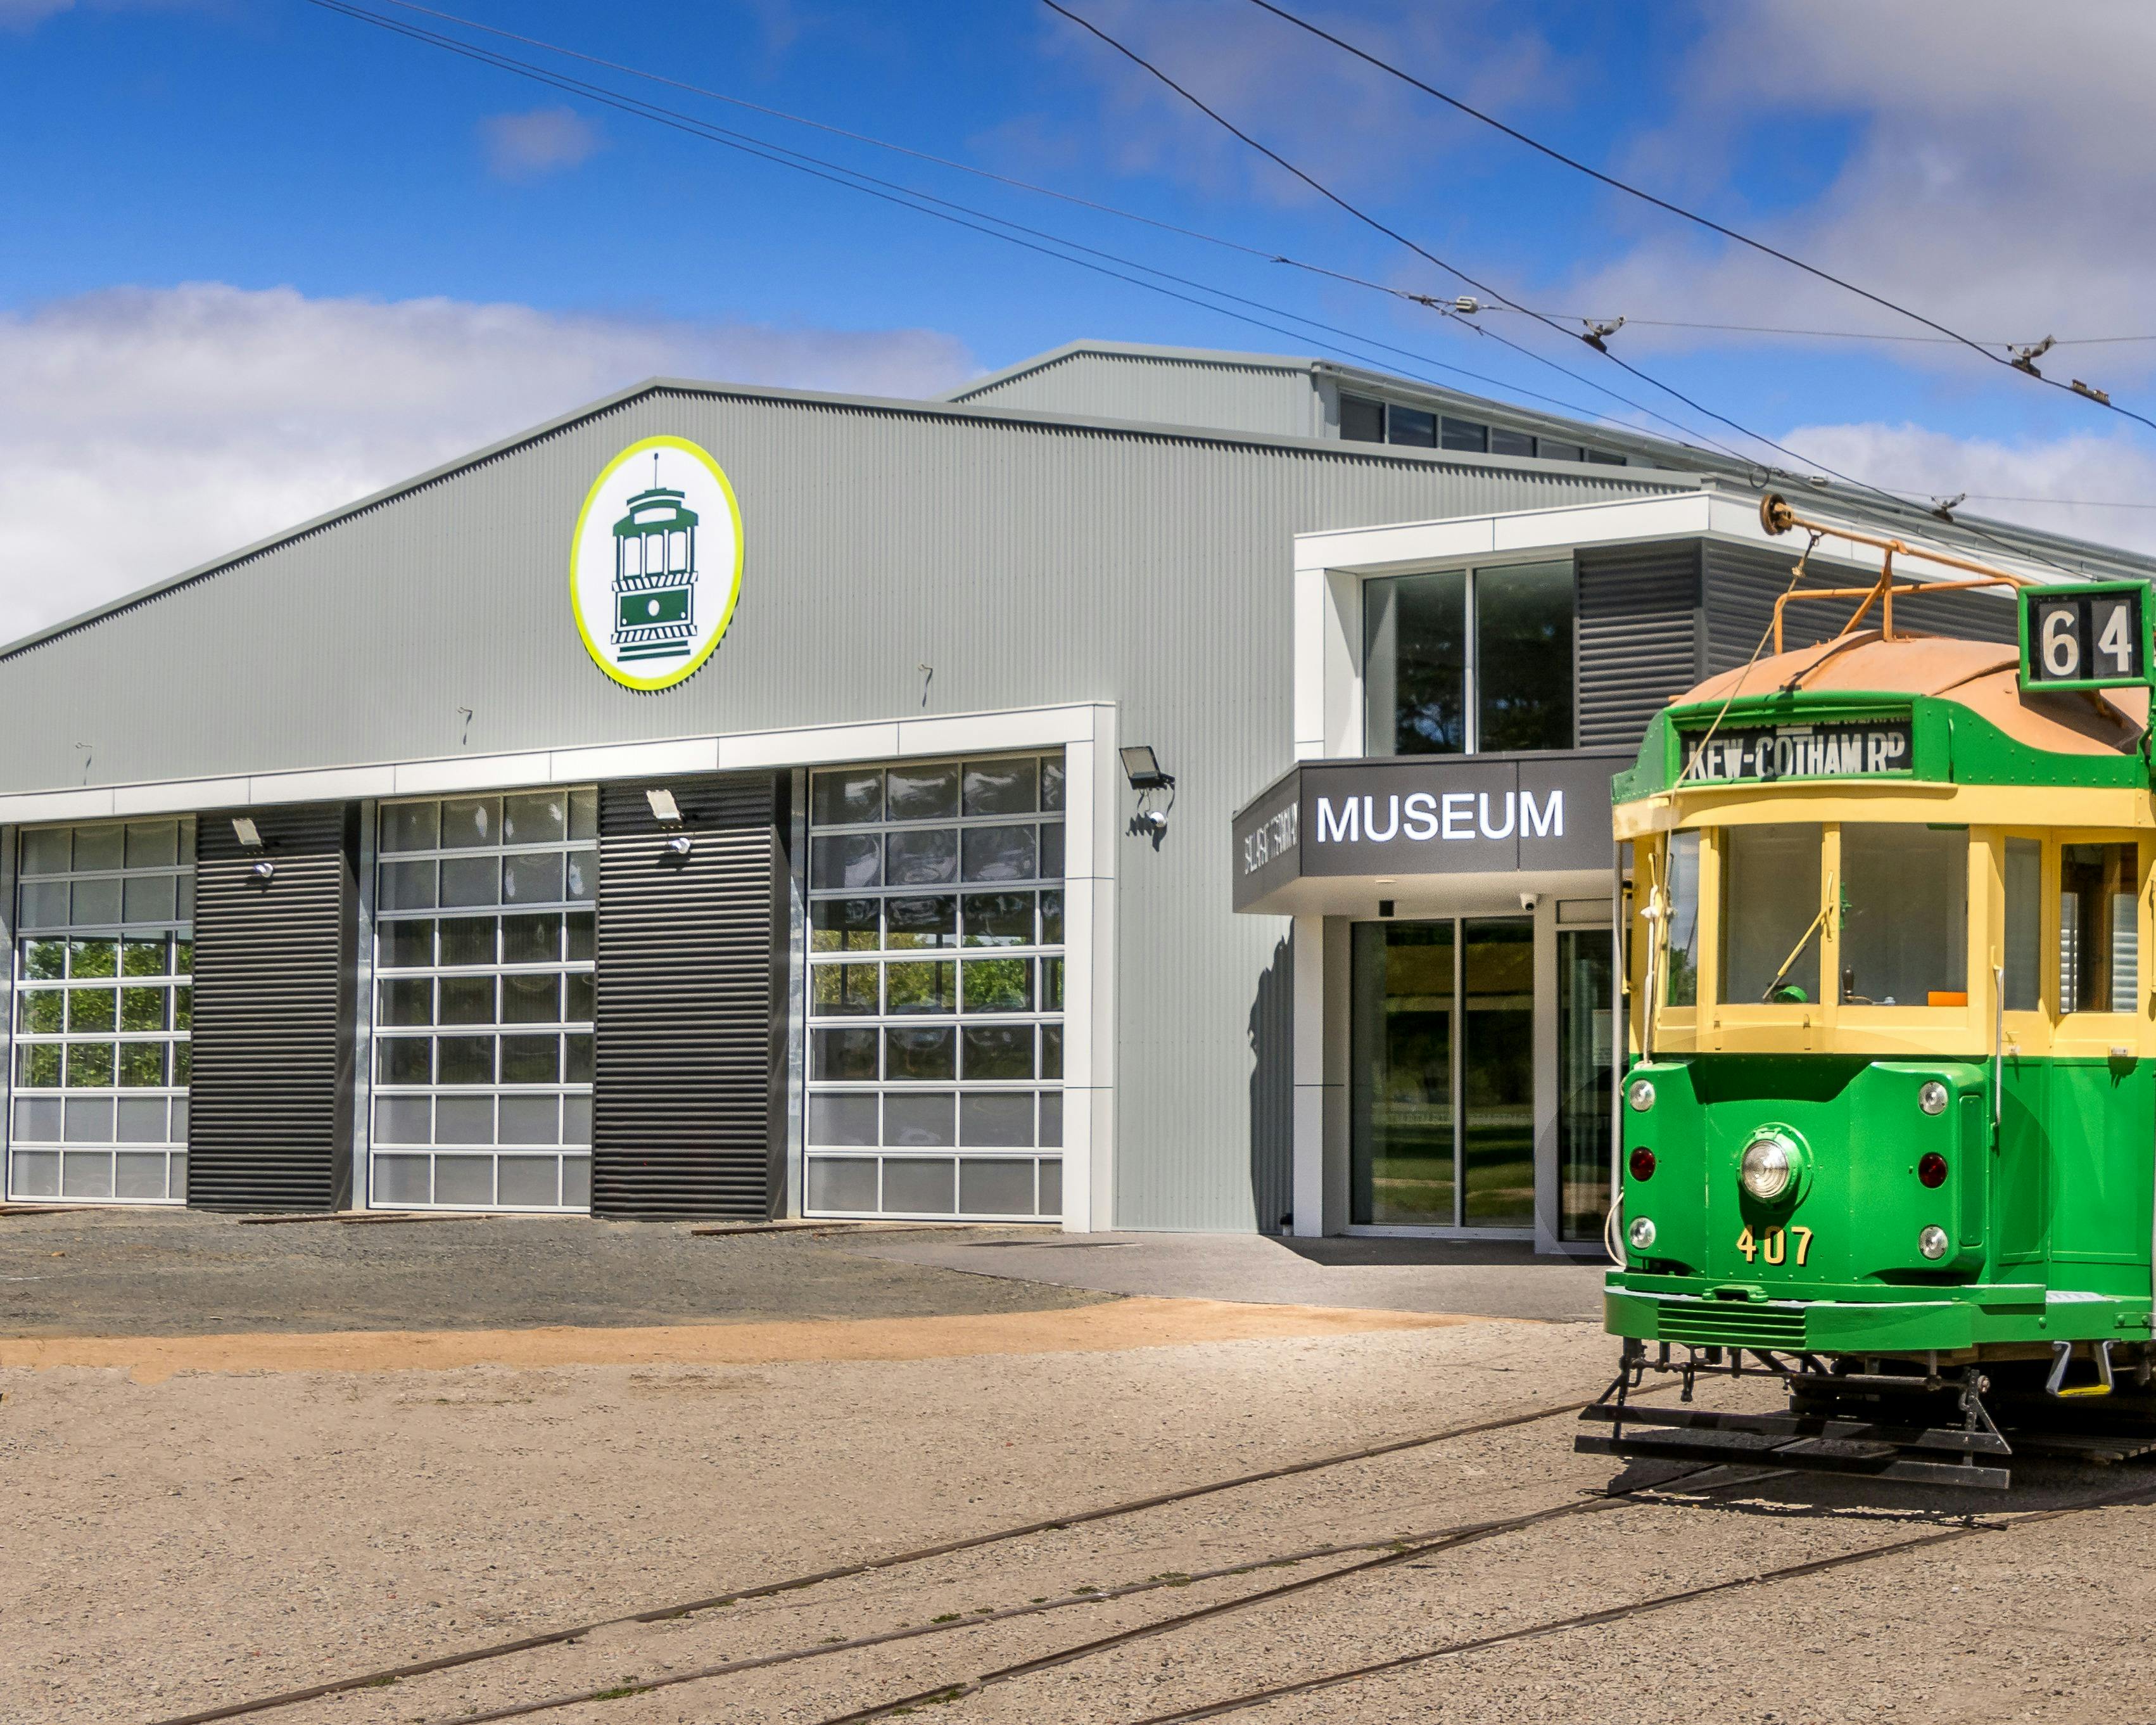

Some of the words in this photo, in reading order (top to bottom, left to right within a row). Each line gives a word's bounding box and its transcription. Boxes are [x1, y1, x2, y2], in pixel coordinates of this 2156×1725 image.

[2043, 606, 2132, 676] 64
[1317, 790, 1564, 843] MUSEUM
[1736, 1225, 1813, 1266] 407
